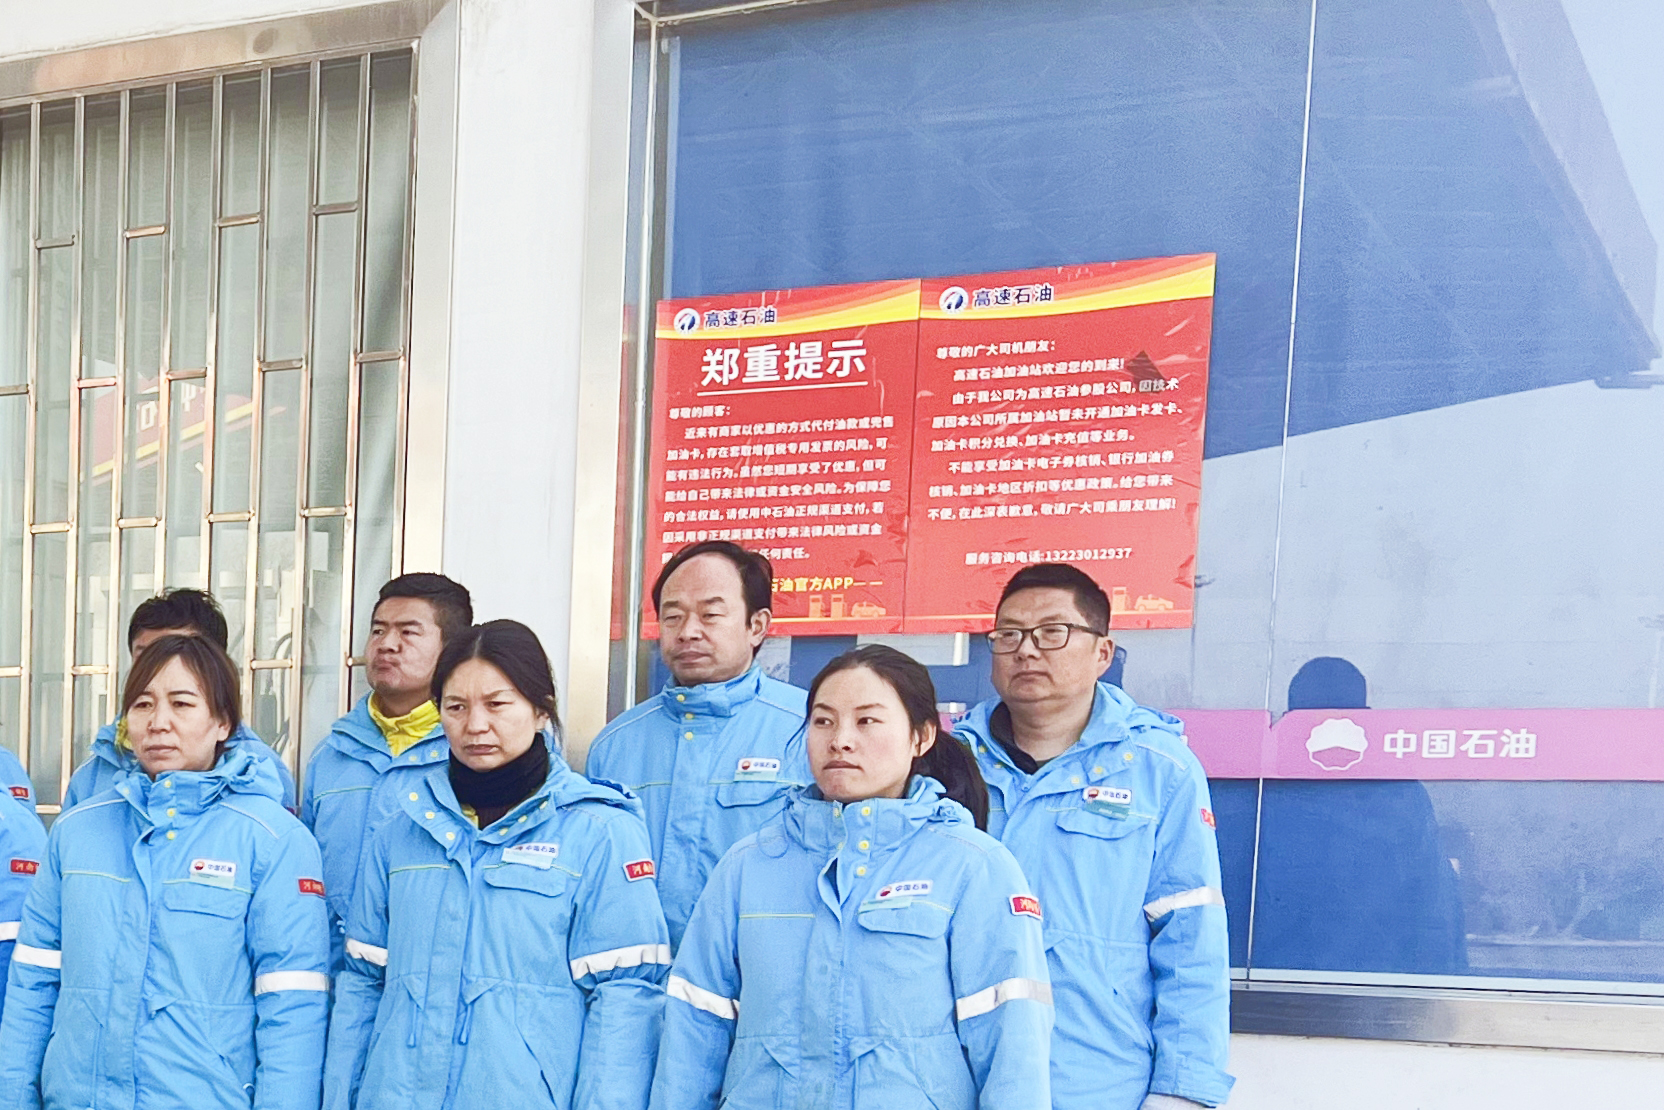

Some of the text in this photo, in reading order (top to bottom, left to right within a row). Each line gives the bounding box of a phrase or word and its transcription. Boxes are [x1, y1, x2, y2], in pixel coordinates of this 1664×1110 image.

[973, 285, 1053, 307] 高速石油
[704, 306, 776, 328] 高速石油
[700, 339, 867, 386] 郑重提示
[1383, 728, 1537, 759] 中国石油
